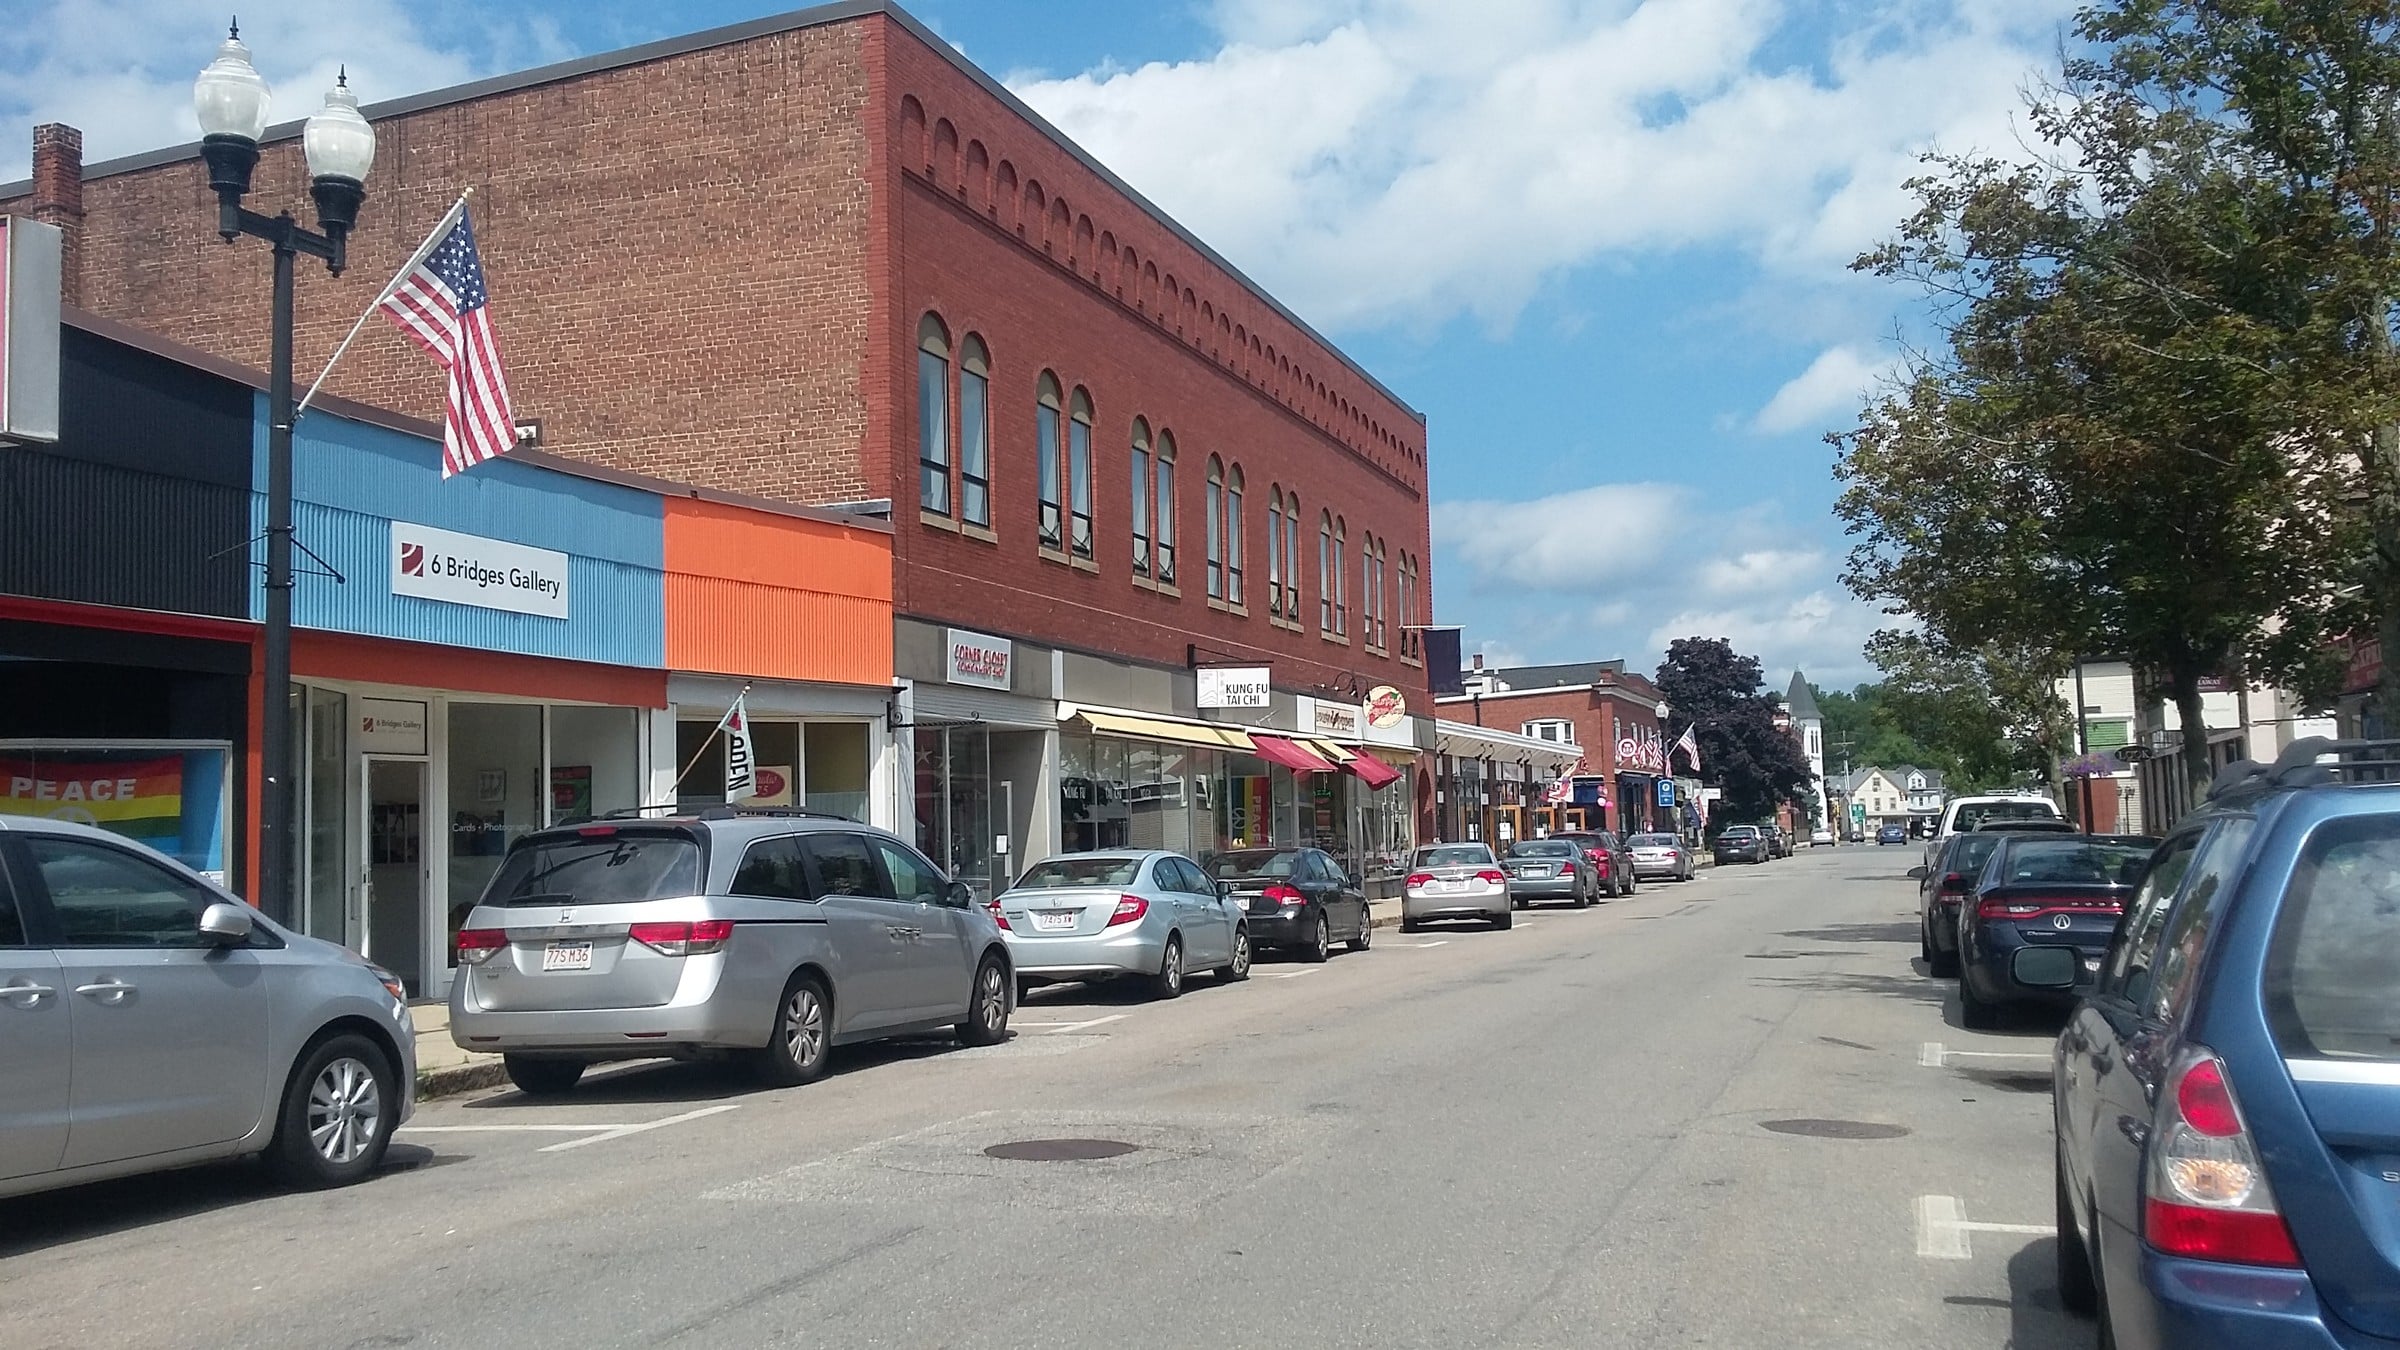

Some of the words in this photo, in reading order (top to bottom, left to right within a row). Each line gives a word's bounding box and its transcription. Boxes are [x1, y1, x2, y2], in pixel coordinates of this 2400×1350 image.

[431, 554, 441, 574] 6
[447, 557, 505, 588] Bridges
[509, 568, 560, 599] Gallery
[954, 644, 980, 662] CORNER
[984, 649, 1008, 667] CLOSET
[1226, 684, 1253, 694] KUNG
[1256, 683, 1268, 694] FU
[1226, 695, 1240, 705] TAI
[1243, 695, 1260, 705] CHI
[382, 719, 402, 729] Bridges
[403, 720, 421, 730] Gallery
[10, 776, 137, 801] PEACE
[1252, 795, 1262, 841] PEACE
[452, 822, 476, 832] Cards
[547, 949, 567, 963] 77S
